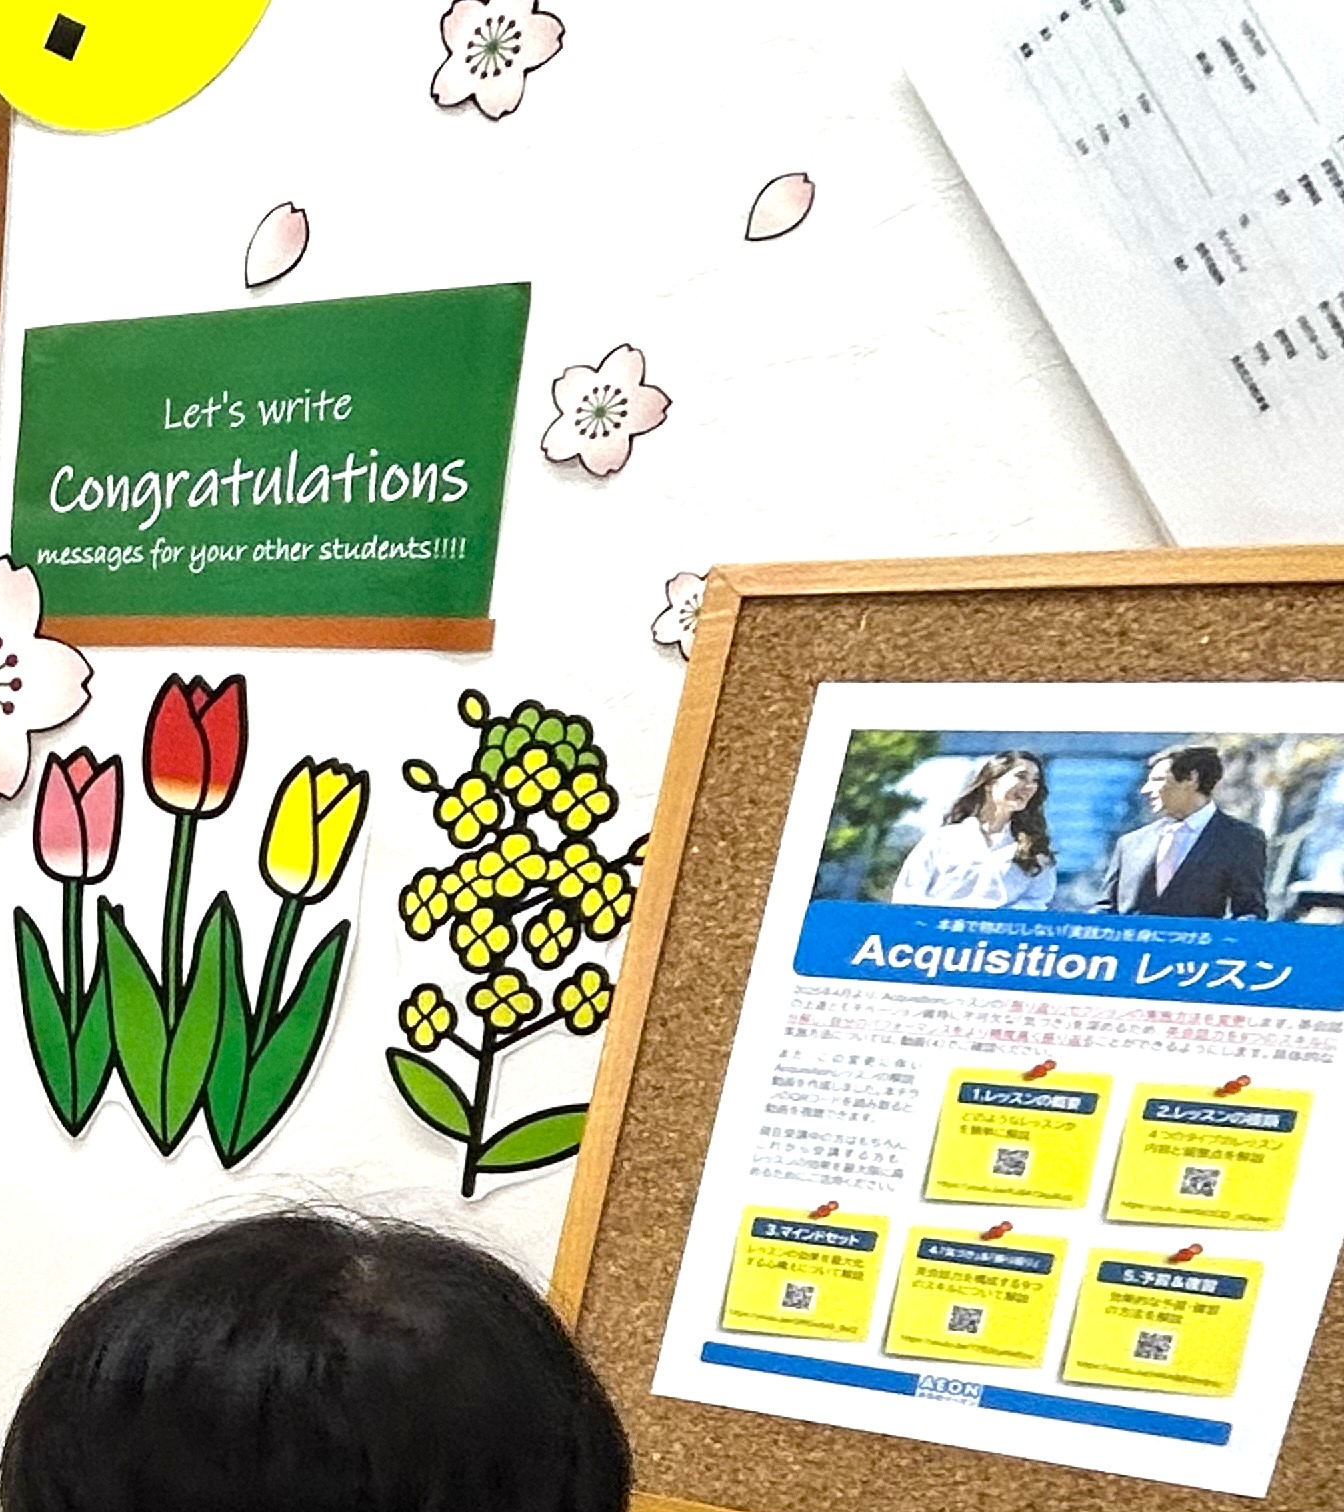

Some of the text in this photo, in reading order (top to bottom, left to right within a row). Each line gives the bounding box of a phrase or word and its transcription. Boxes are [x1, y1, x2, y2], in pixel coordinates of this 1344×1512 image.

[165, 389, 353, 430] Let's write
[50, 449, 469, 530] Congratulations
[37, 535, 467, 573] messages for your other students!!!!
[851, 934, 1292, 993] Acquisition レッスン
